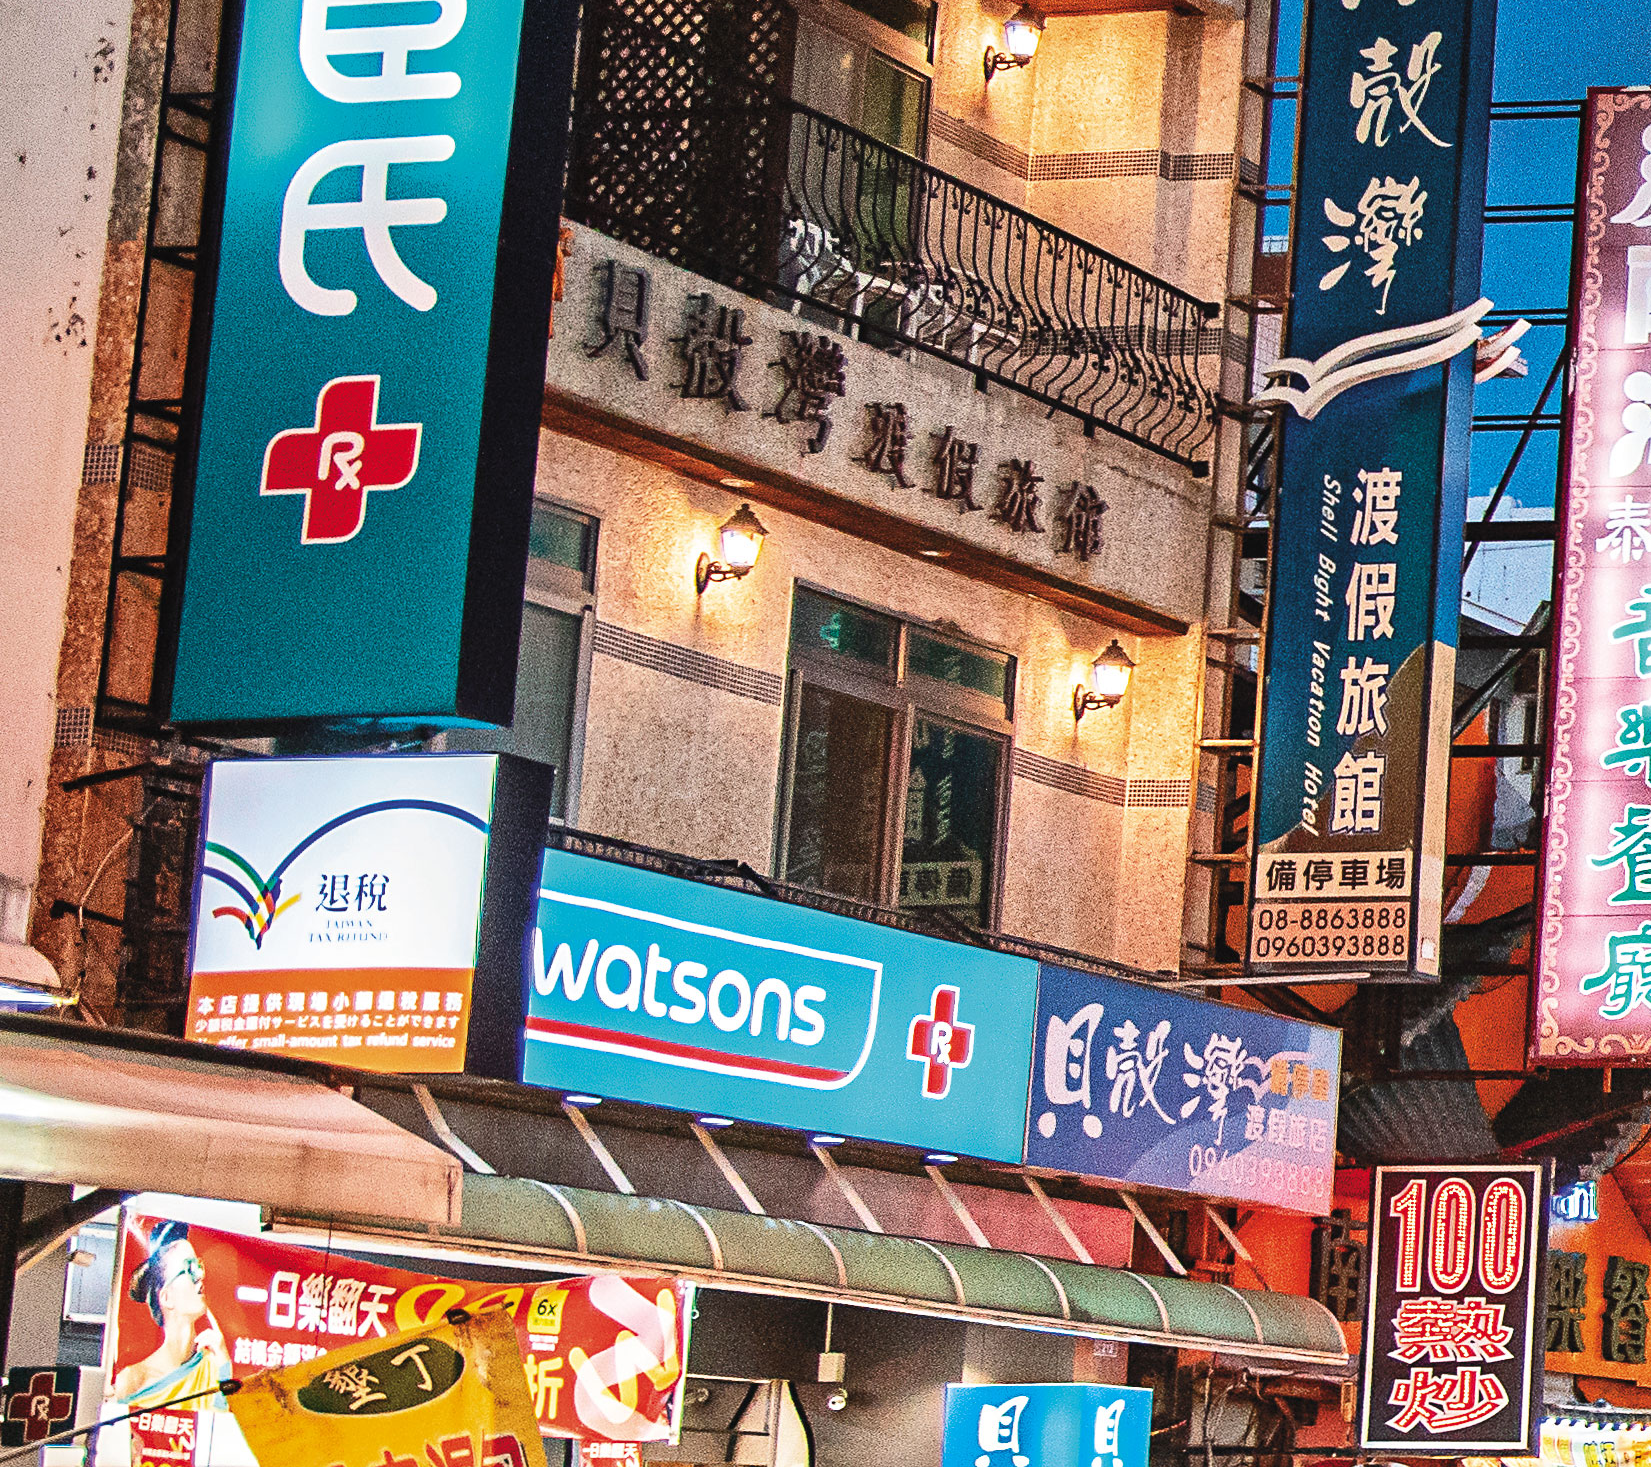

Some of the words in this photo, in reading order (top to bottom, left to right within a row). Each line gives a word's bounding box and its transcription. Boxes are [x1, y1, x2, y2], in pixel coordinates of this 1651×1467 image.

[1306, 474, 1341, 543] Shell
[1316, 552, 1339, 624] Bight
[1328, 466, 1404, 836] 渡假旅館
[1306, 640, 1333, 748] Vacation
[1299, 762, 1325, 838] Hotel
[315, 872, 390, 913] 退稅
[1265, 856, 1407, 895] 備停車場
[1256, 933, 1405, 959] 0960393888
[1258, 905, 1406, 932] 08-8863888
[531, 926, 828, 1047] watsons
[341, 1034, 363, 1048] tax
[365, 1032, 409, 1048] refund
[411, 1035, 456, 1048] service
[1037, 1002, 1251, 1146] 貝殼灣
[1389, 1176, 1527, 1295] 100
[236, 1270, 399, 1338] 一日樂翻天
[323, 1344, 433, 1412] 墾丁
[1384, 1295, 1515, 1434] 熱炒
